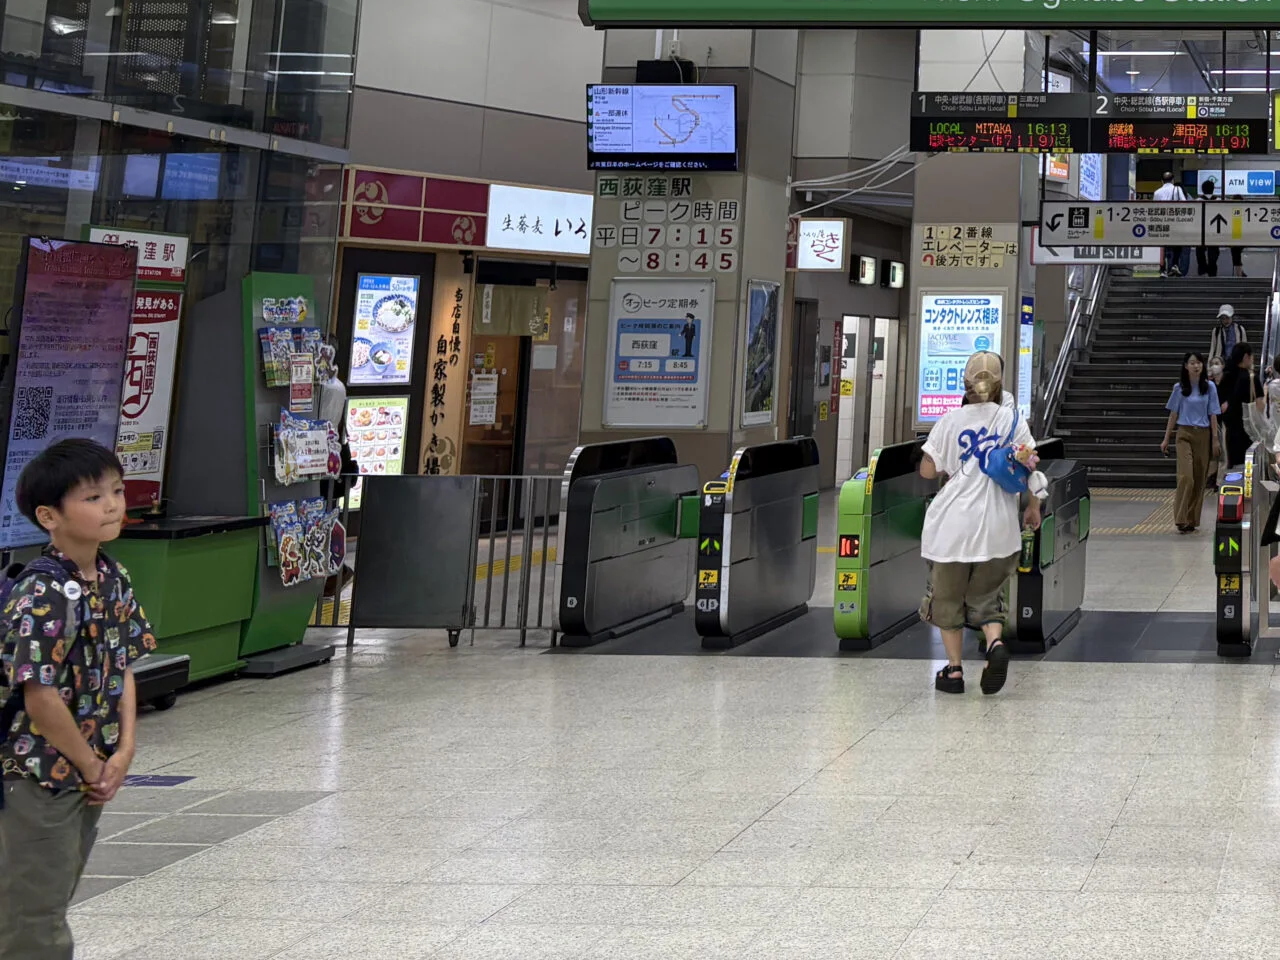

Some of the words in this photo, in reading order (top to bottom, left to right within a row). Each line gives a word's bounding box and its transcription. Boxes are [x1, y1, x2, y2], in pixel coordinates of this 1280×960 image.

[919, 95, 926, 113] 1
[1096, 96, 1108, 115] 2
[930, 123, 964, 135] LOCAL
[975, 123, 1012, 135] MITAKA
[1027, 123, 1067, 135] 16:13
[1172, 123, 1208, 137] 津田沼
[1215, 124, 1250, 137] 16:13
[599, 177, 691, 197] 西荻窪駅
[623, 201, 738, 221] ピーク時間
[502, 213, 544, 235] 生蕎麦
[926, 226, 993, 240] 1・2番線
[922, 240, 1018, 255] エレベーターは
[935, 254, 999, 268] 後方です。
[136, 297, 177, 311] 発見がある。
[924, 307, 999, 324] コンタクトレンズ相談
[449, 287, 464, 367] 当店自慢の
[631, 340, 658, 349] 西荻窪
[637, 361, 653, 369] 7:15
[672, 361, 688, 369] 8:45
